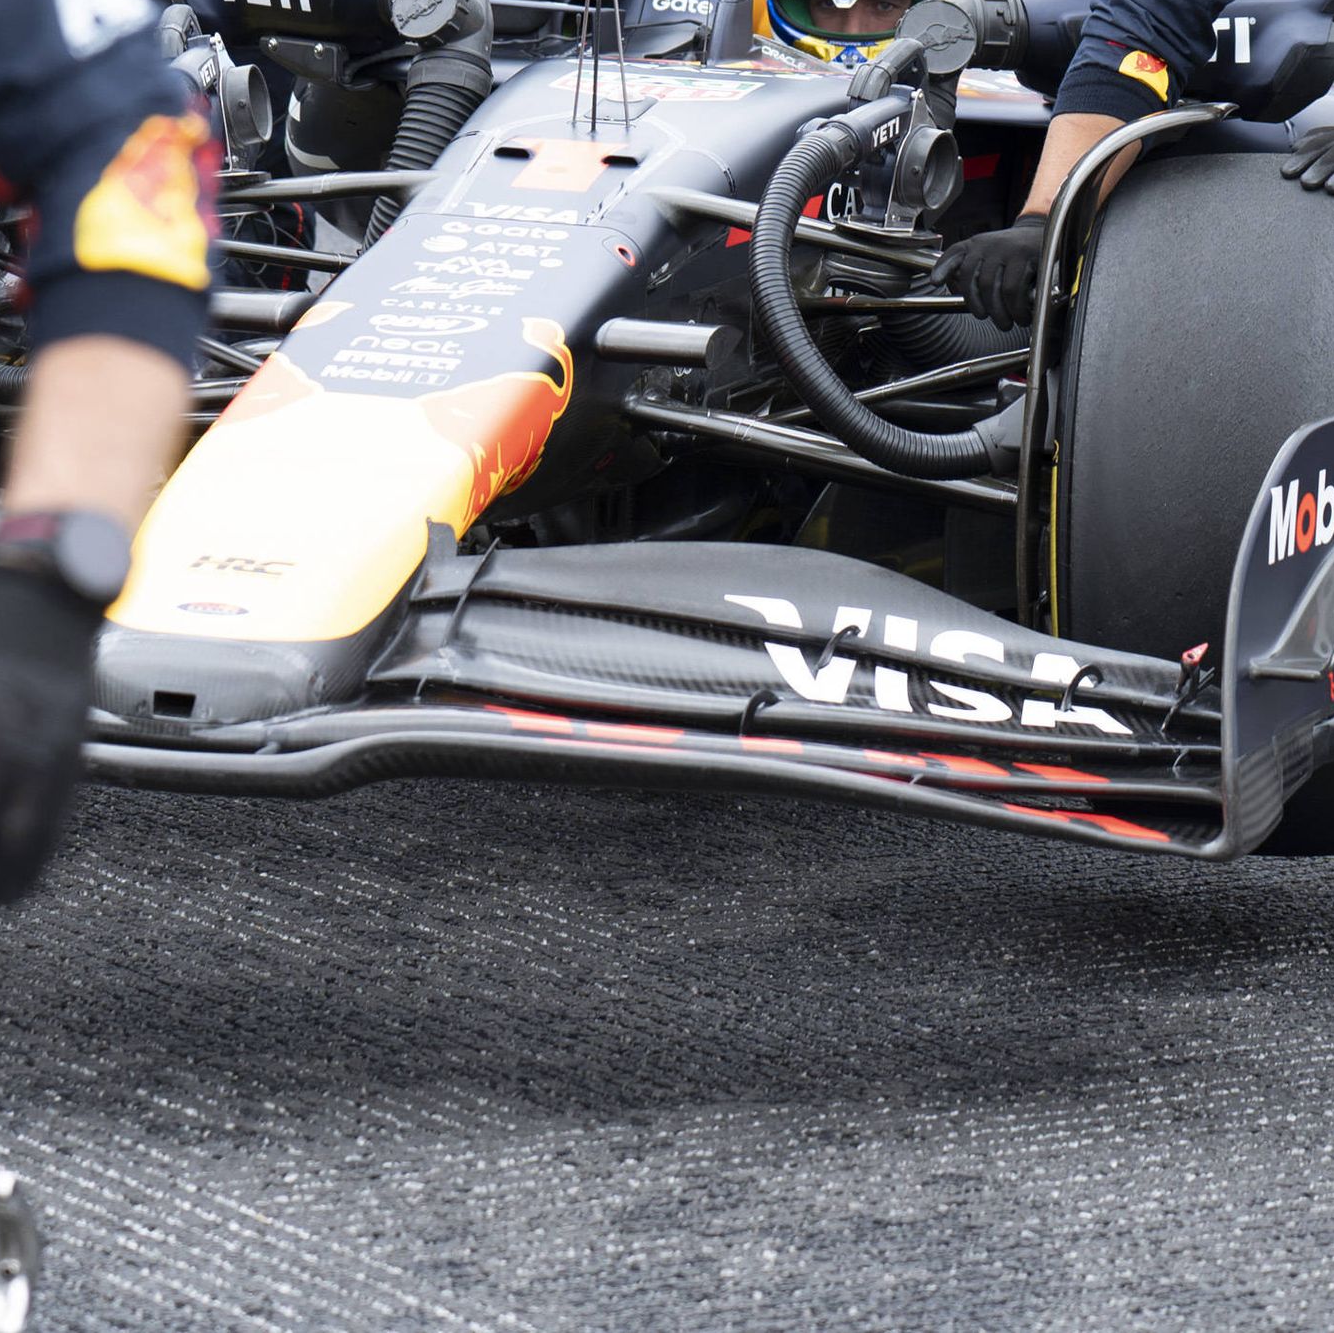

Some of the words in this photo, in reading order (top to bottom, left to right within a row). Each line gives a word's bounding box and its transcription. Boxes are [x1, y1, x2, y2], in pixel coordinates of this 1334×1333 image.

[761, 45, 807, 71] ORACLE
[871, 116, 901, 149] YETI
[465, 201, 579, 224] VISA
[473, 223, 569, 241] Gate
[469, 241, 562, 259] AT&T
[380, 297, 505, 316] CARLYLE
[320, 364, 414, 384] Mobil
[724, 594, 1135, 736] VISA
